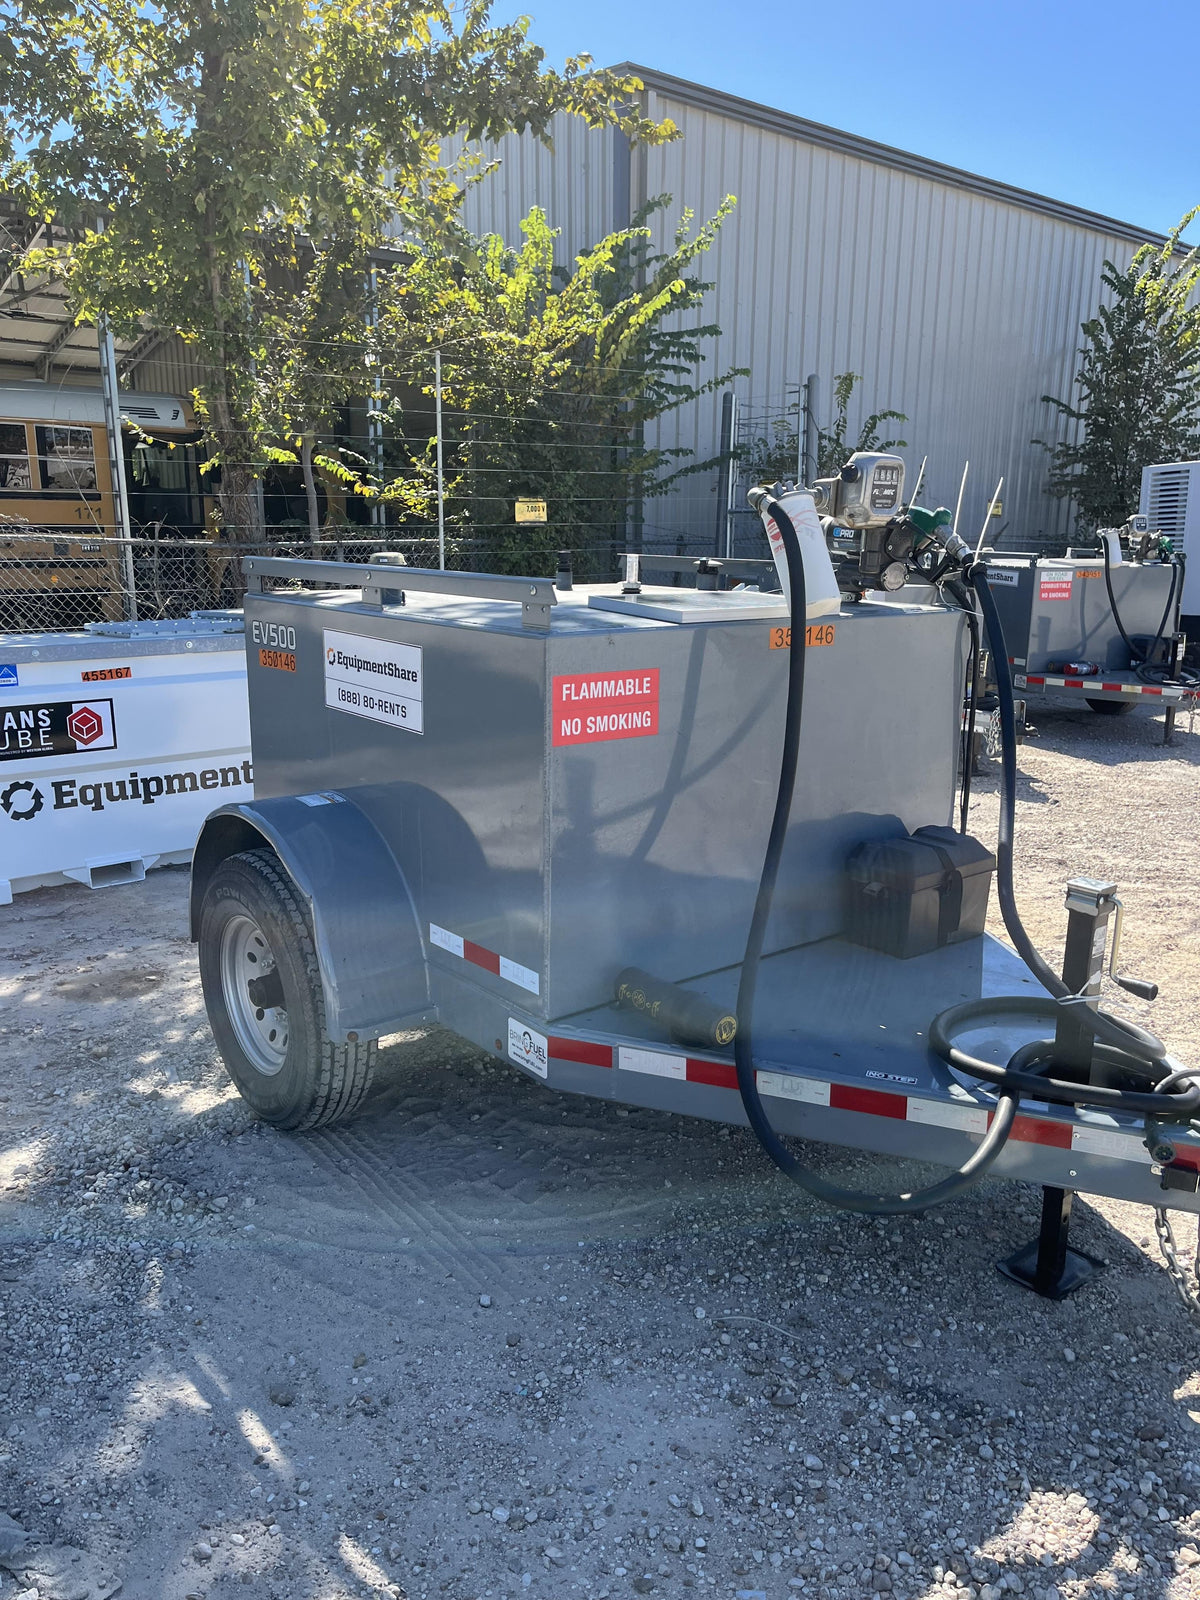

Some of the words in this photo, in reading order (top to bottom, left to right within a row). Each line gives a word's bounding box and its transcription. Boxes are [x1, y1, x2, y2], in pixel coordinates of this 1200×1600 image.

[75, 507, 102, 519] 171
[252, 620, 297, 650] EV500
[774, 625, 835, 648] 35146
[261, 650, 297, 672] 350146
[336, 651, 418, 682] EquipmentShare
[82, 667, 131, 682] 455167
[562, 677, 651, 701] FLAMMABLE
[338, 687, 361, 707] (888)
[363, 694, 407, 719] 80-RENTS
[561, 718, 581, 737] NO
[586, 710, 651, 734] SMOKING
[51, 760, 253, 811] Equipment
